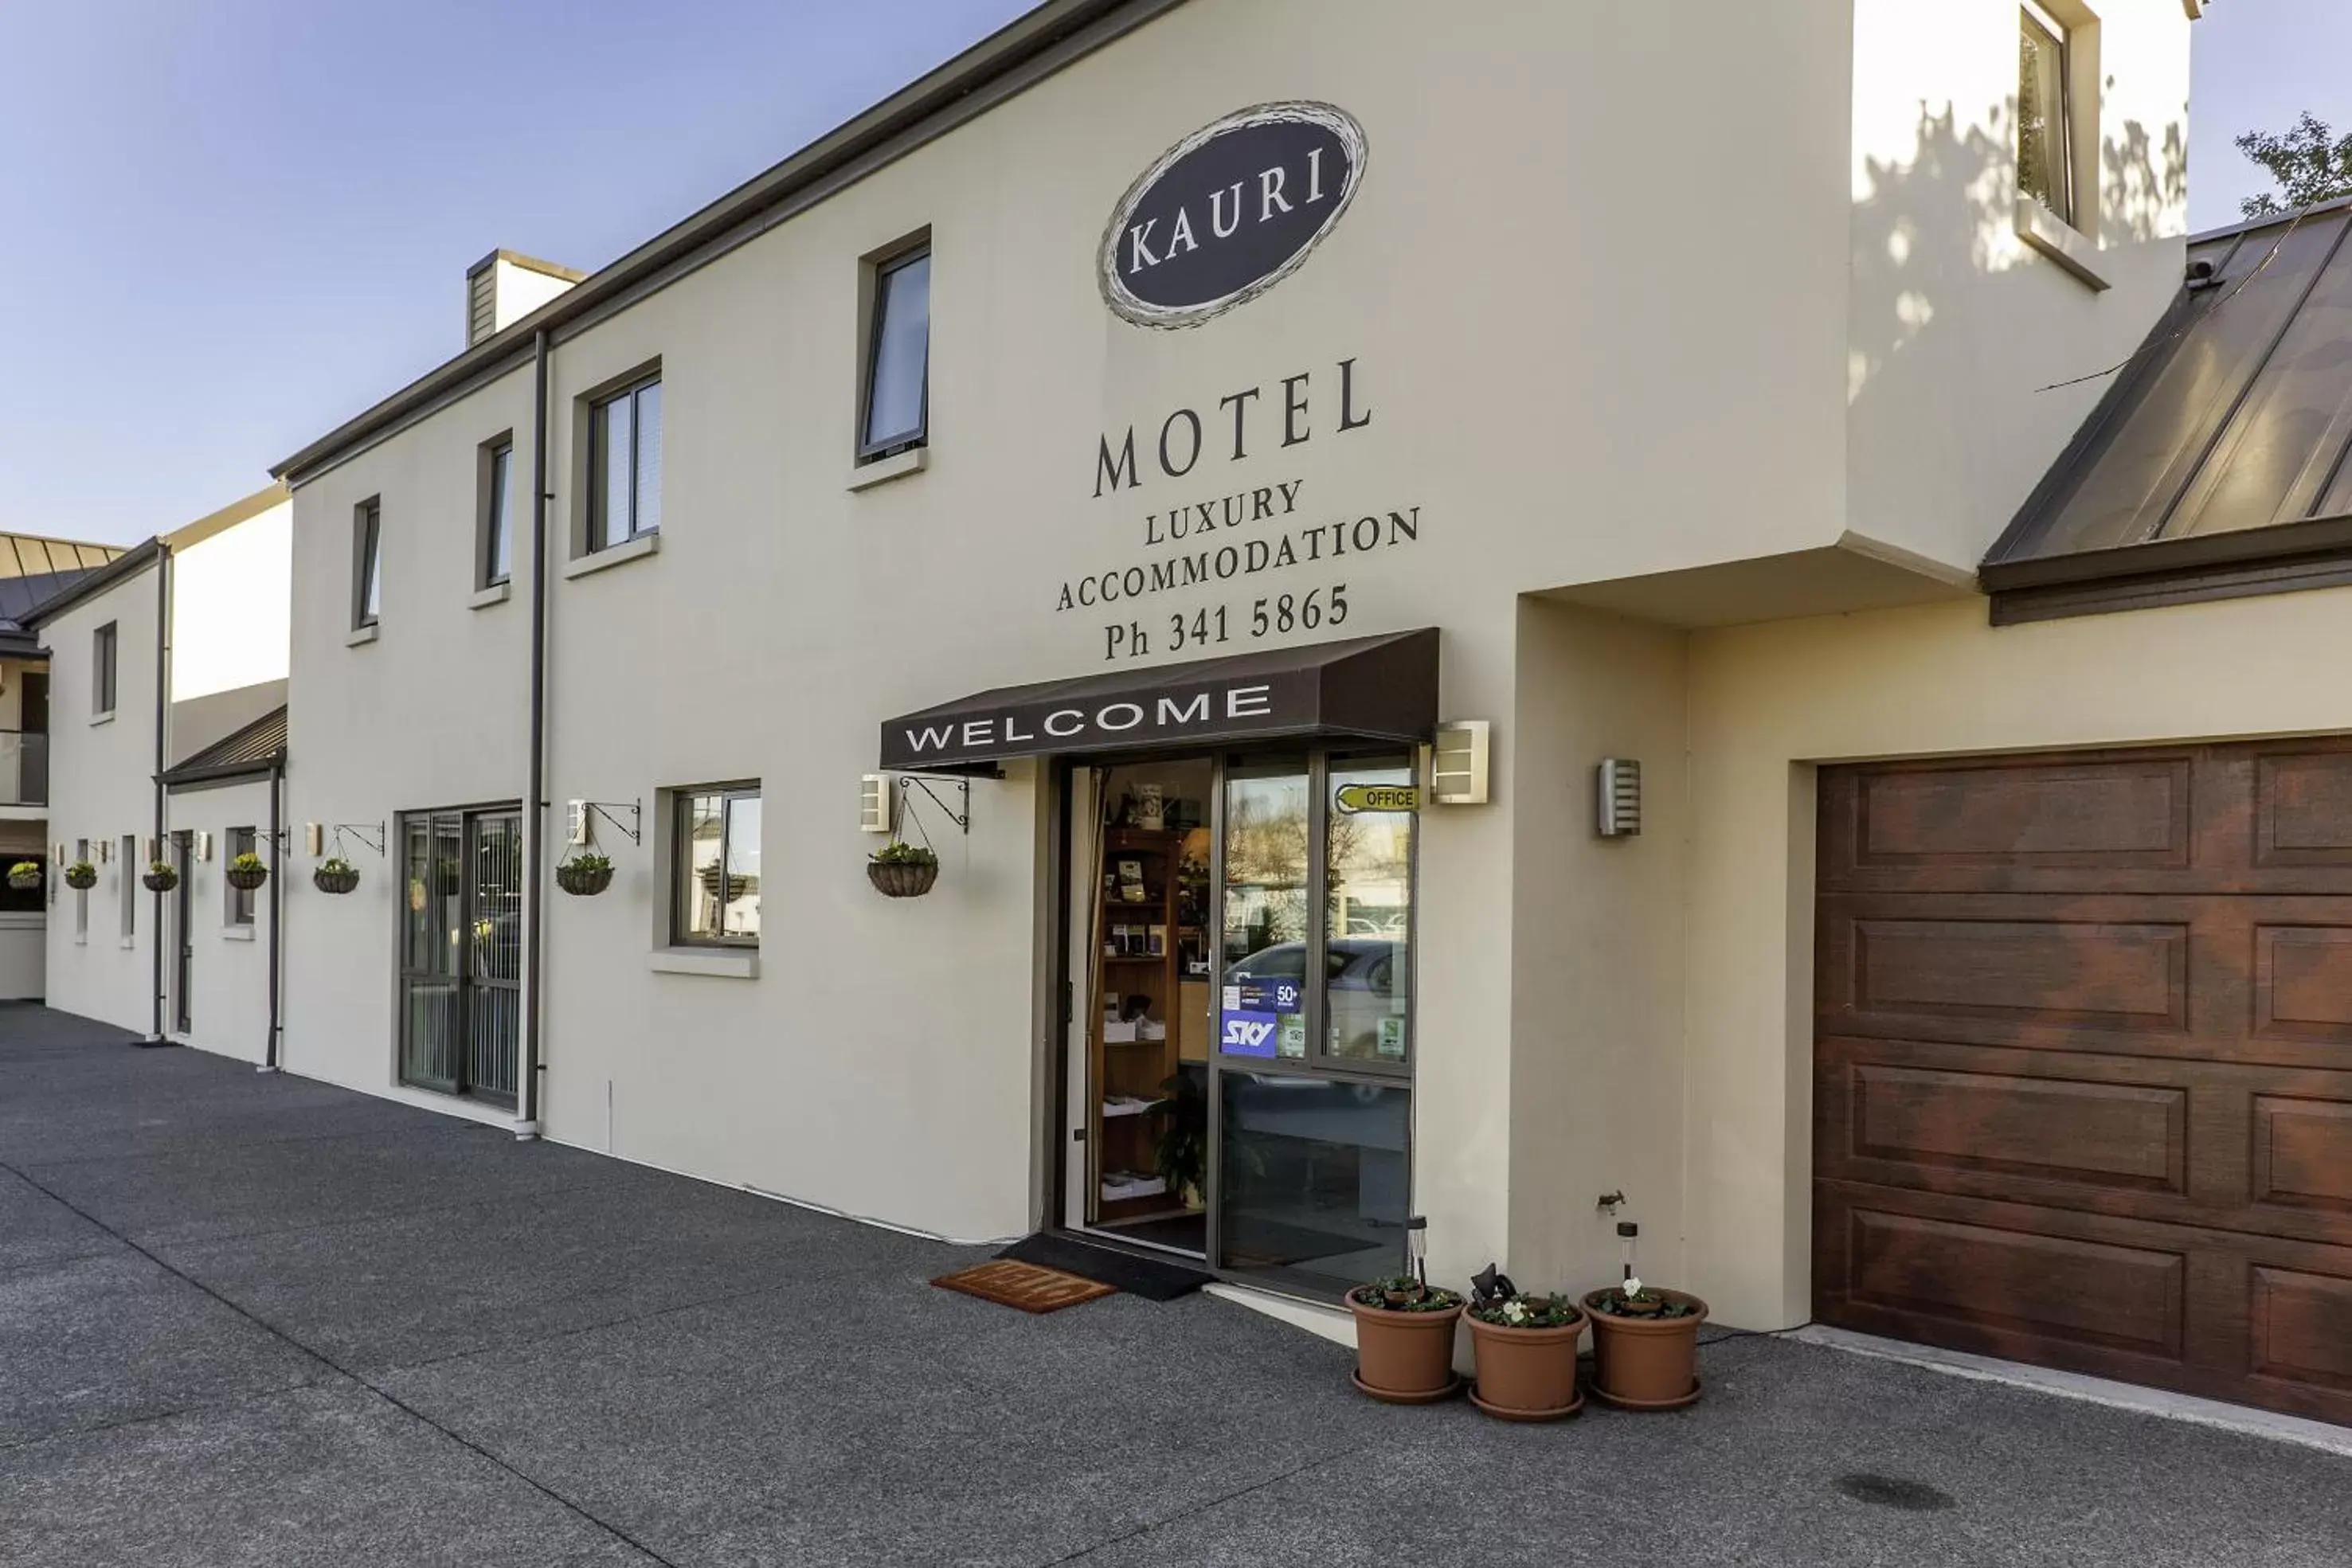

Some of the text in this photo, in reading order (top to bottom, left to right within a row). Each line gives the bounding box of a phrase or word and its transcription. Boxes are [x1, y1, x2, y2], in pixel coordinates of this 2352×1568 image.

[1129, 148, 1325, 274] KAURI
[1092, 357, 1372, 499] MOTEL
[1145, 479, 1305, 546] LUXURY
[1056, 506, 1421, 612] ACCOMMODATION
[1105, 583, 1348, 661] Ph 341 5865
[905, 684, 1272, 753] WELCOME
[1365, 791, 1415, 806] OFFICE
[1222, 1020, 1276, 1047] SKY
